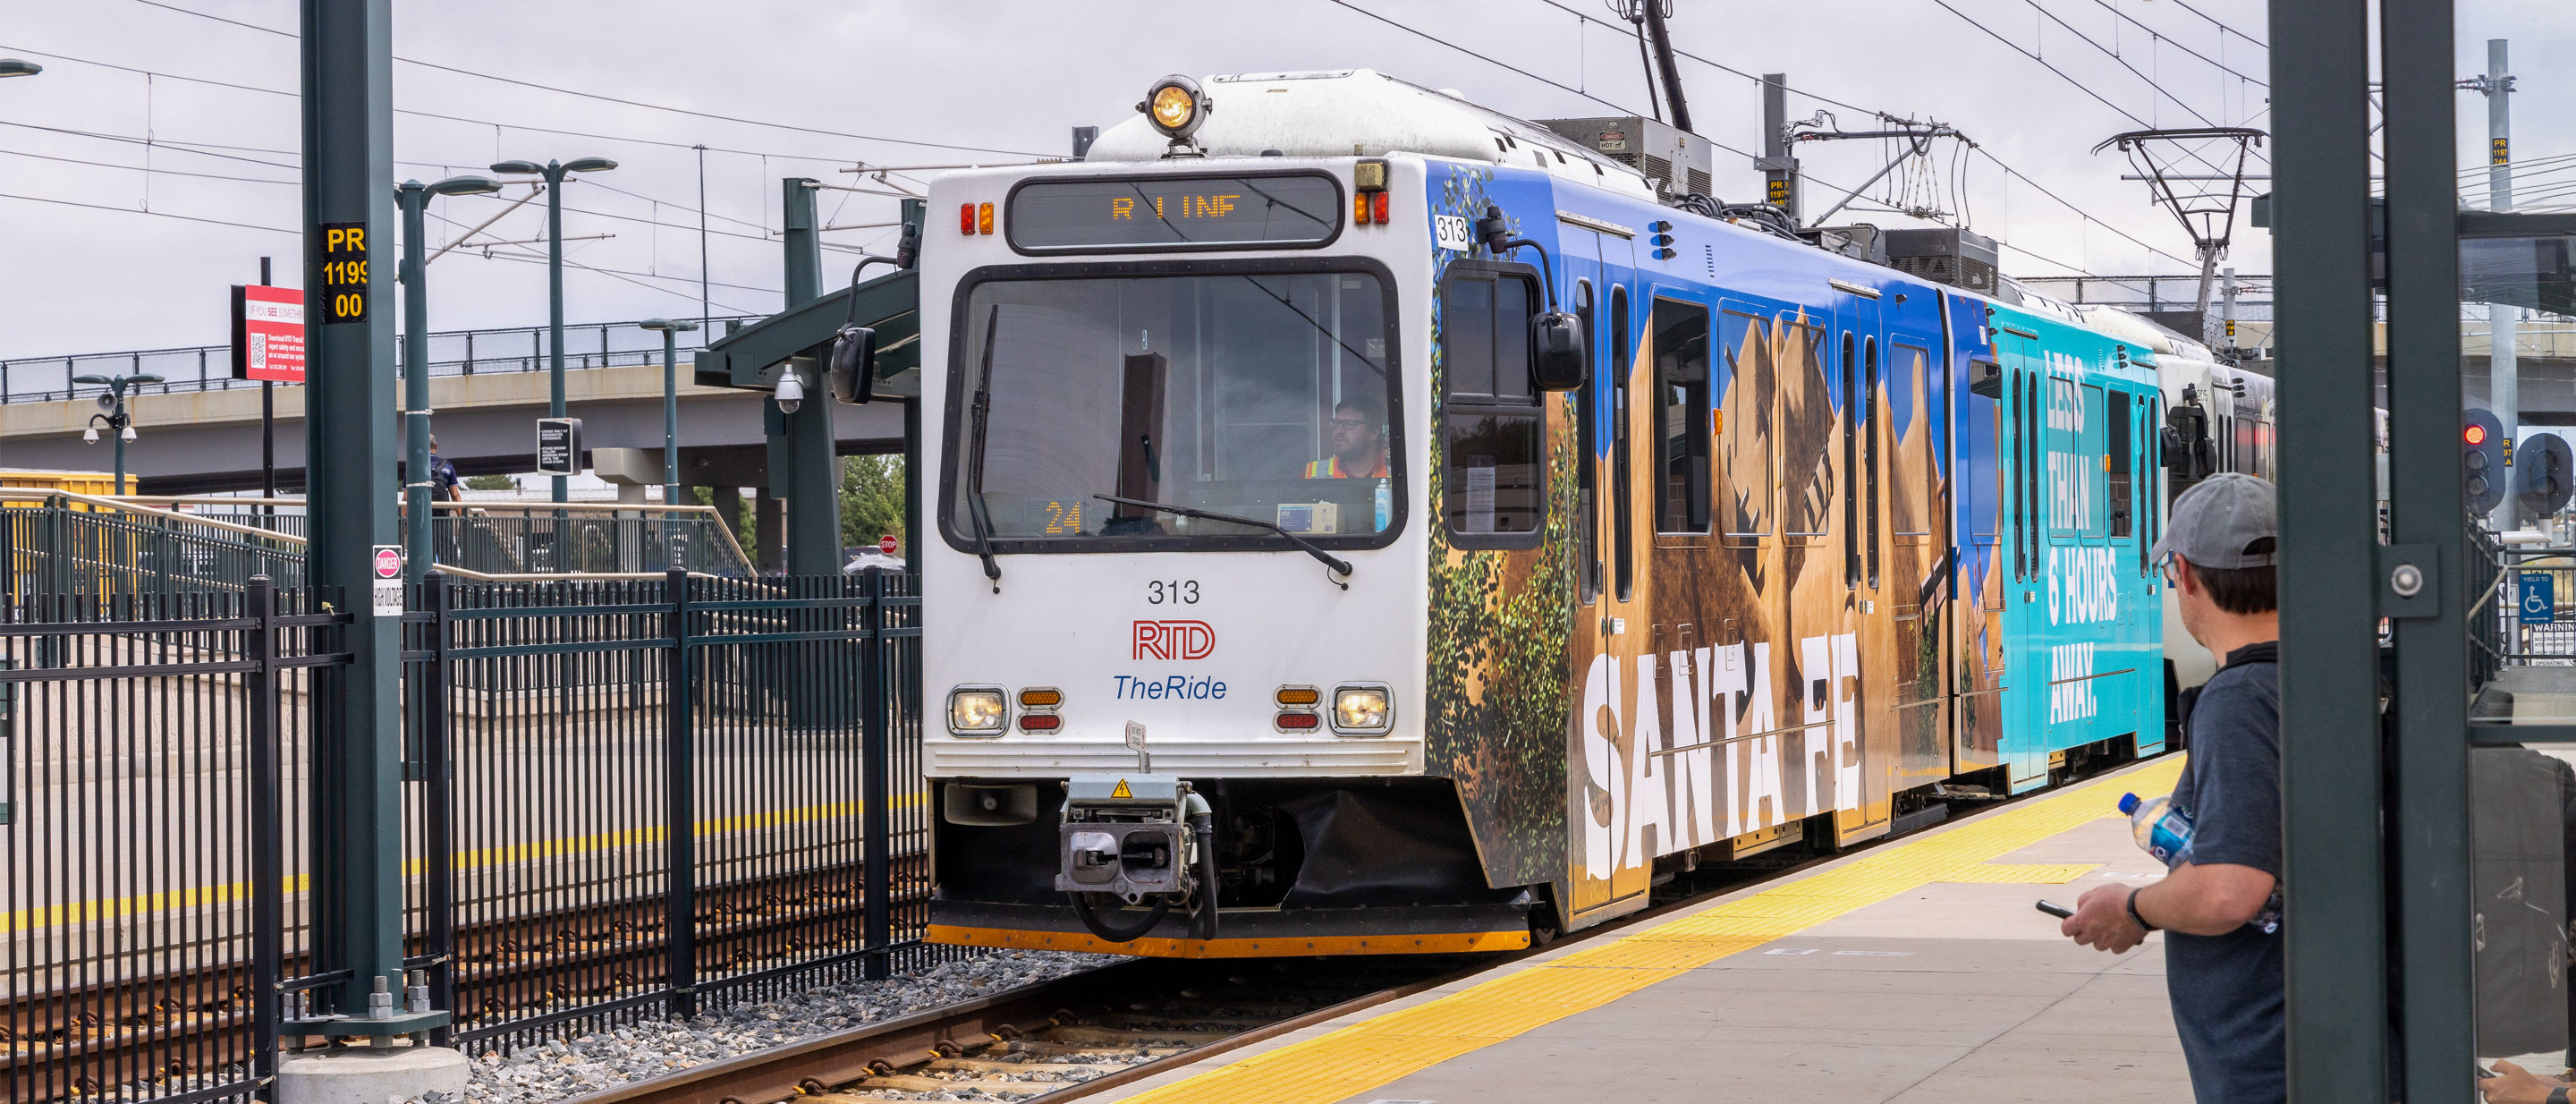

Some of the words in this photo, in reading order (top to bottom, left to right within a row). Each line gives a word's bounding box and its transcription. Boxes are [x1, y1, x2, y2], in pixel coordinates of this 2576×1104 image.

[2493, 149, 2508, 157] 1197
[1770, 181, 1783, 190] PR
[1113, 198, 1134, 220] R
[327, 227, 366, 252] PR
[1437, 217, 1466, 242] 313
[256, 306, 267, 317] YOU
[268, 307, 277, 317] SEE
[335, 293, 362, 318] 00
[2044, 350, 2085, 435] LESS
[2048, 450, 2090, 531] THAN
[1046, 501, 1080, 533] 24
[881, 540, 897, 548] STOP
[377, 556, 398, 570] DANGER
[385, 587, 402, 607] VOLTAGE
[1148, 580, 1200, 605] 313
[2047, 547, 2060, 626] 6
[2064, 547, 2117, 624] HOURS
[1132, 620, 1216, 660] RTD
[1114, 675, 1227, 700] TheRide
[2050, 641, 2097, 726] AWAY.
[1583, 640, 1786, 880] SANTA
[1801, 630, 1860, 817] FE
